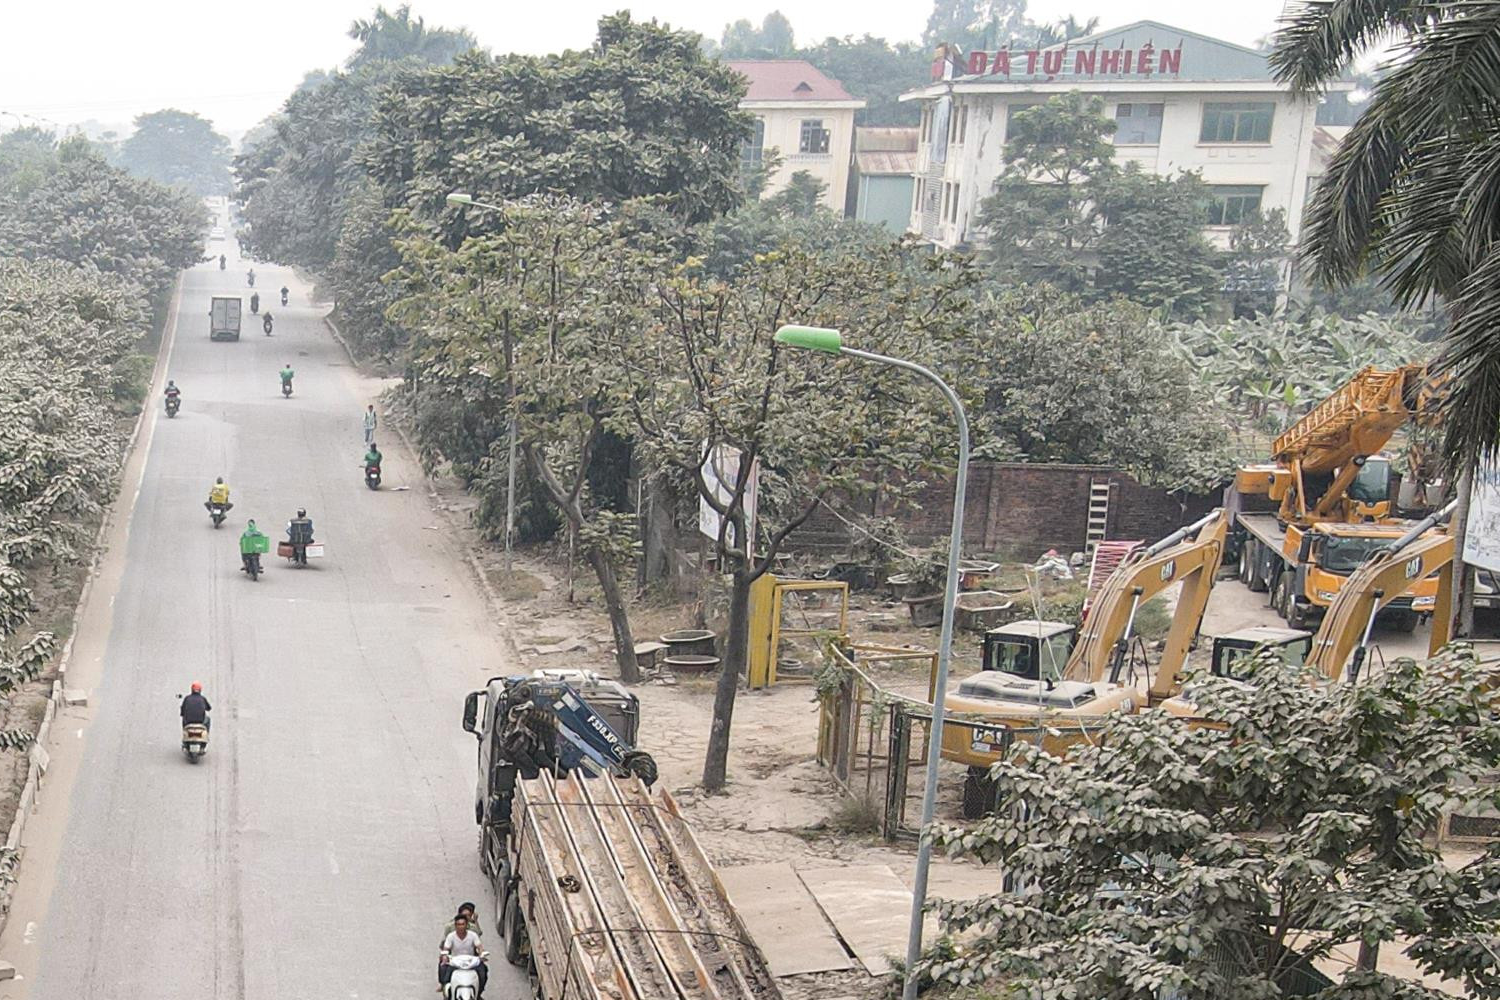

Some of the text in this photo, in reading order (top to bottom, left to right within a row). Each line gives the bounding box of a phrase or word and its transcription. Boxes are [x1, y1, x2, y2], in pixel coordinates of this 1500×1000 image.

[966, 43, 1182, 80] ĐÁ TỰ NHIÊN
